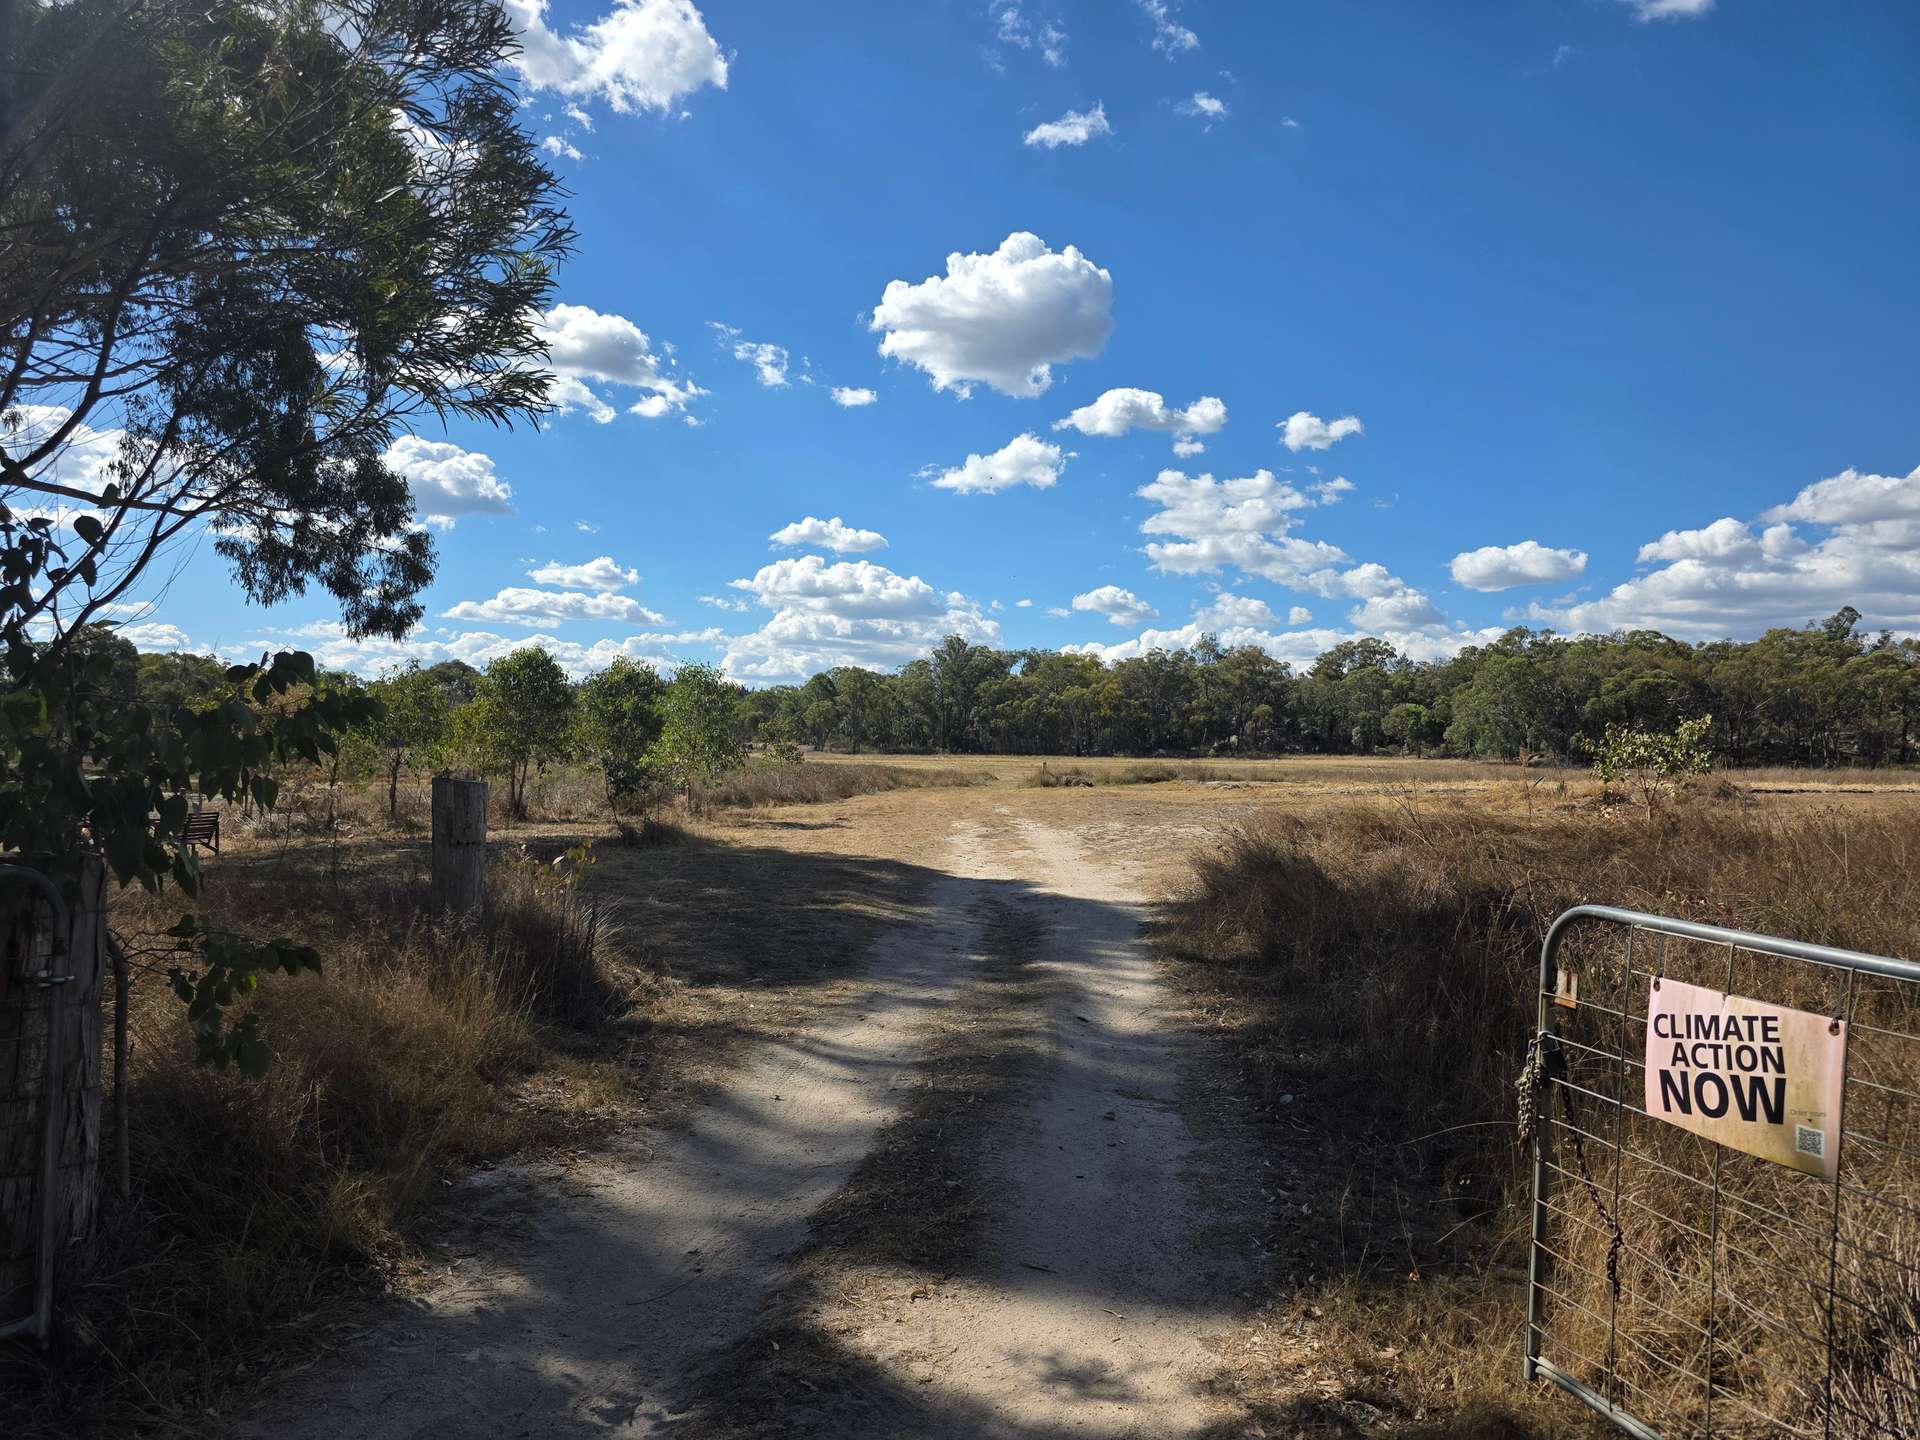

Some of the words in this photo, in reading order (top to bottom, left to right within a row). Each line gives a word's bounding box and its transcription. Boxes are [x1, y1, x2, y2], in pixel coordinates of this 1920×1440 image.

[1653, 1014, 1780, 1043] CLIMATE
[1671, 1043, 1786, 1074] ACTION
[1659, 1069, 1786, 1125] NOW
